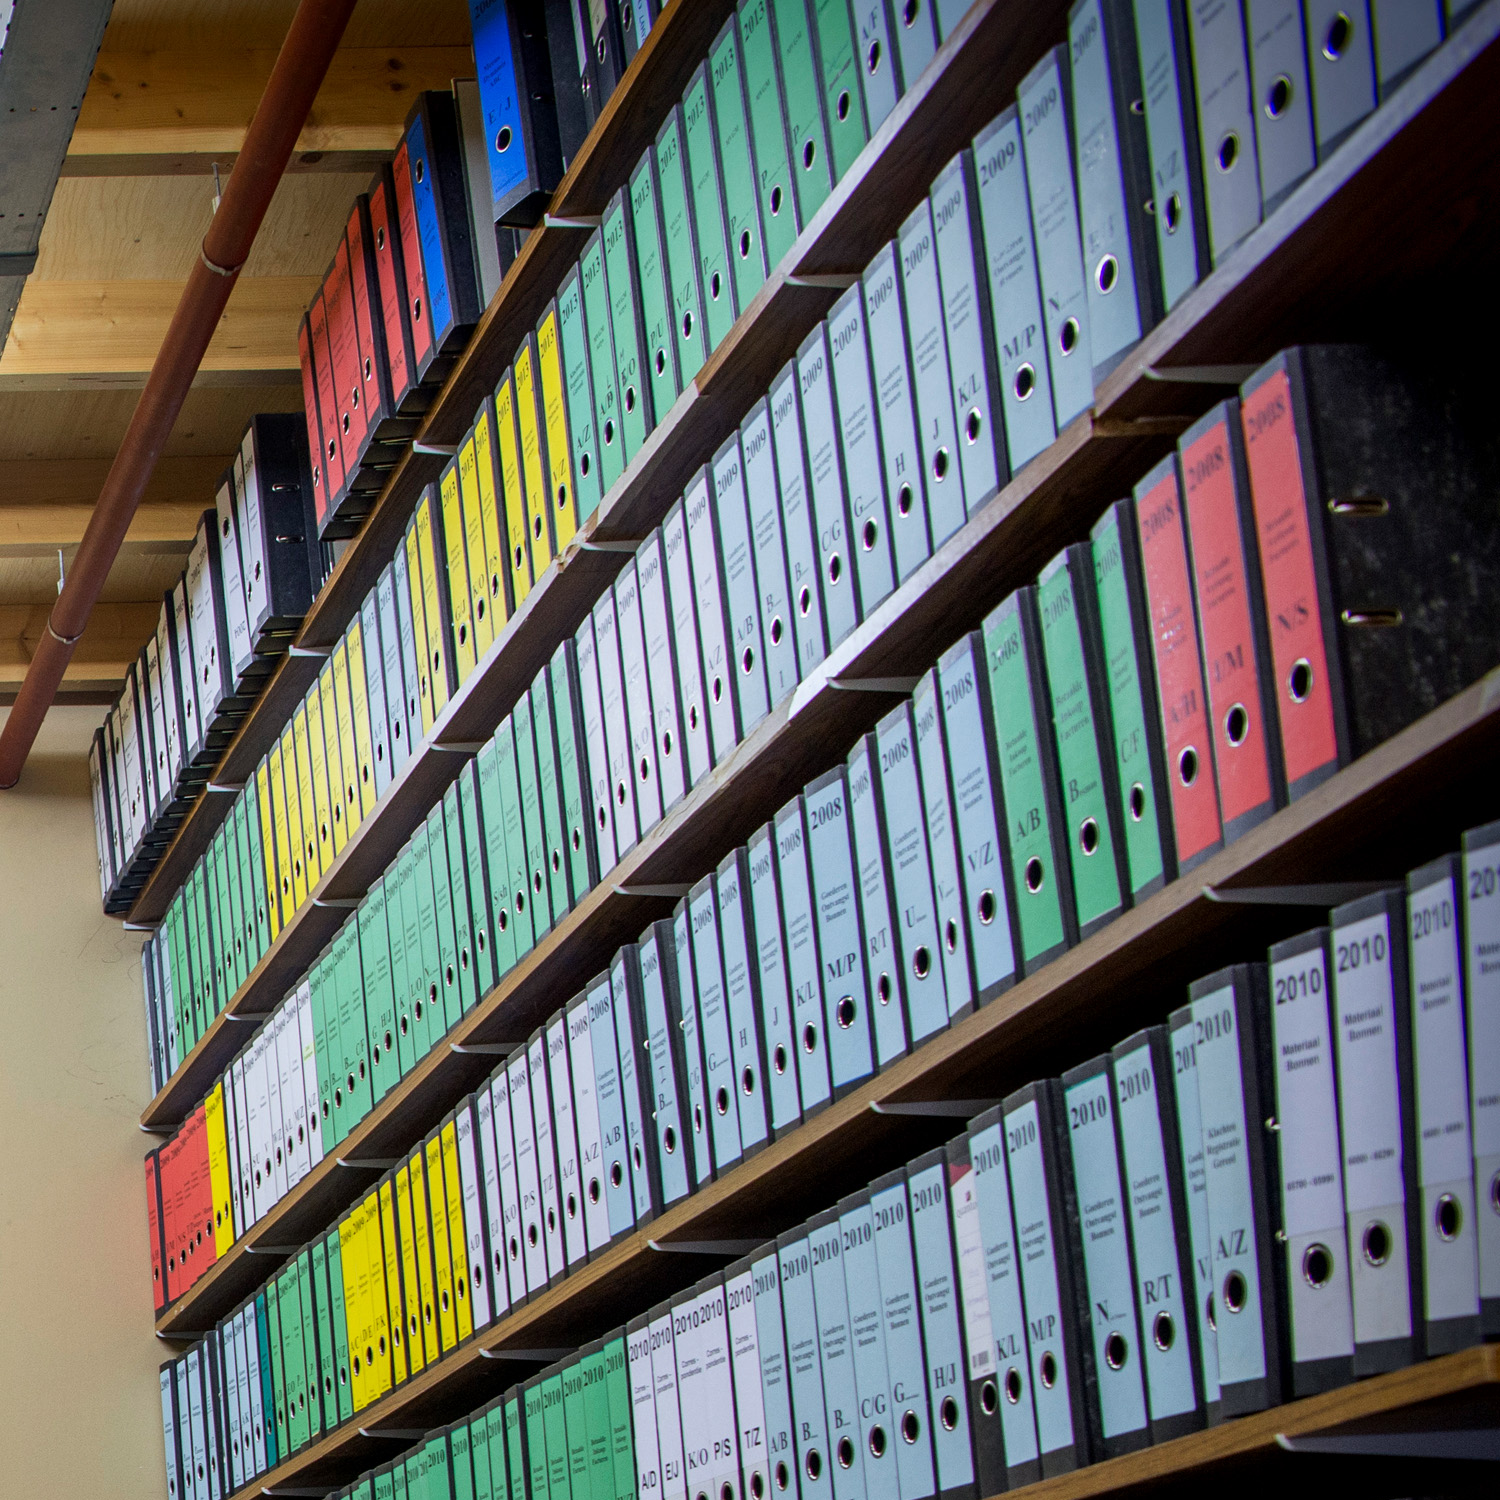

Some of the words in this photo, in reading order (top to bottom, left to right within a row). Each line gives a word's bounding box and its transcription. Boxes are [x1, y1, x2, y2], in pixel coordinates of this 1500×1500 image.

[713, 52, 736, 87] 2013
[979, 140, 1017, 188] 2009
[1002, 323, 1038, 365] M/P
[944, 670, 974, 712] 2008
[810, 796, 842, 831] 2008
[1015, 805, 1043, 842] A/B
[966, 840, 995, 873] V/Z
[1413, 900, 1451, 941] 2010
[826, 951, 857, 983] M/P
[1337, 932, 1386, 974] 2010
[1275, 967, 1322, 1007] 2010
[590, 995, 611, 1024] 2008
[1344, 1005, 1384, 1027] Materiaal
[1196, 1008, 1233, 1047] 2010
[1348, 1023, 1382, 1043] Bonnen
[1281, 1035, 1321, 1057] Materiaal
[1286, 1053, 1320, 1073] Bonnen
[1118, 1066, 1151, 1103] 2010
[1070, 1094, 1108, 1131] 2010
[604, 1124, 622, 1150] A/B
[913, 1180, 943, 1214] 2010
[874, 1200, 905, 1233] 2010
[842, 1220, 873, 1254] 2010
[1215, 1228, 1248, 1262] A/Z
[1143, 1273, 1173, 1305] R/T
[699, 1298, 724, 1325] 2010
[1031, 1313, 1056, 1345] M/P
[933, 1361, 958, 1390] H/J
[860, 1393, 888, 1421] C/G
[713, 1437, 732, 1461] P/S
[744, 1426, 762, 1450] T/Z
